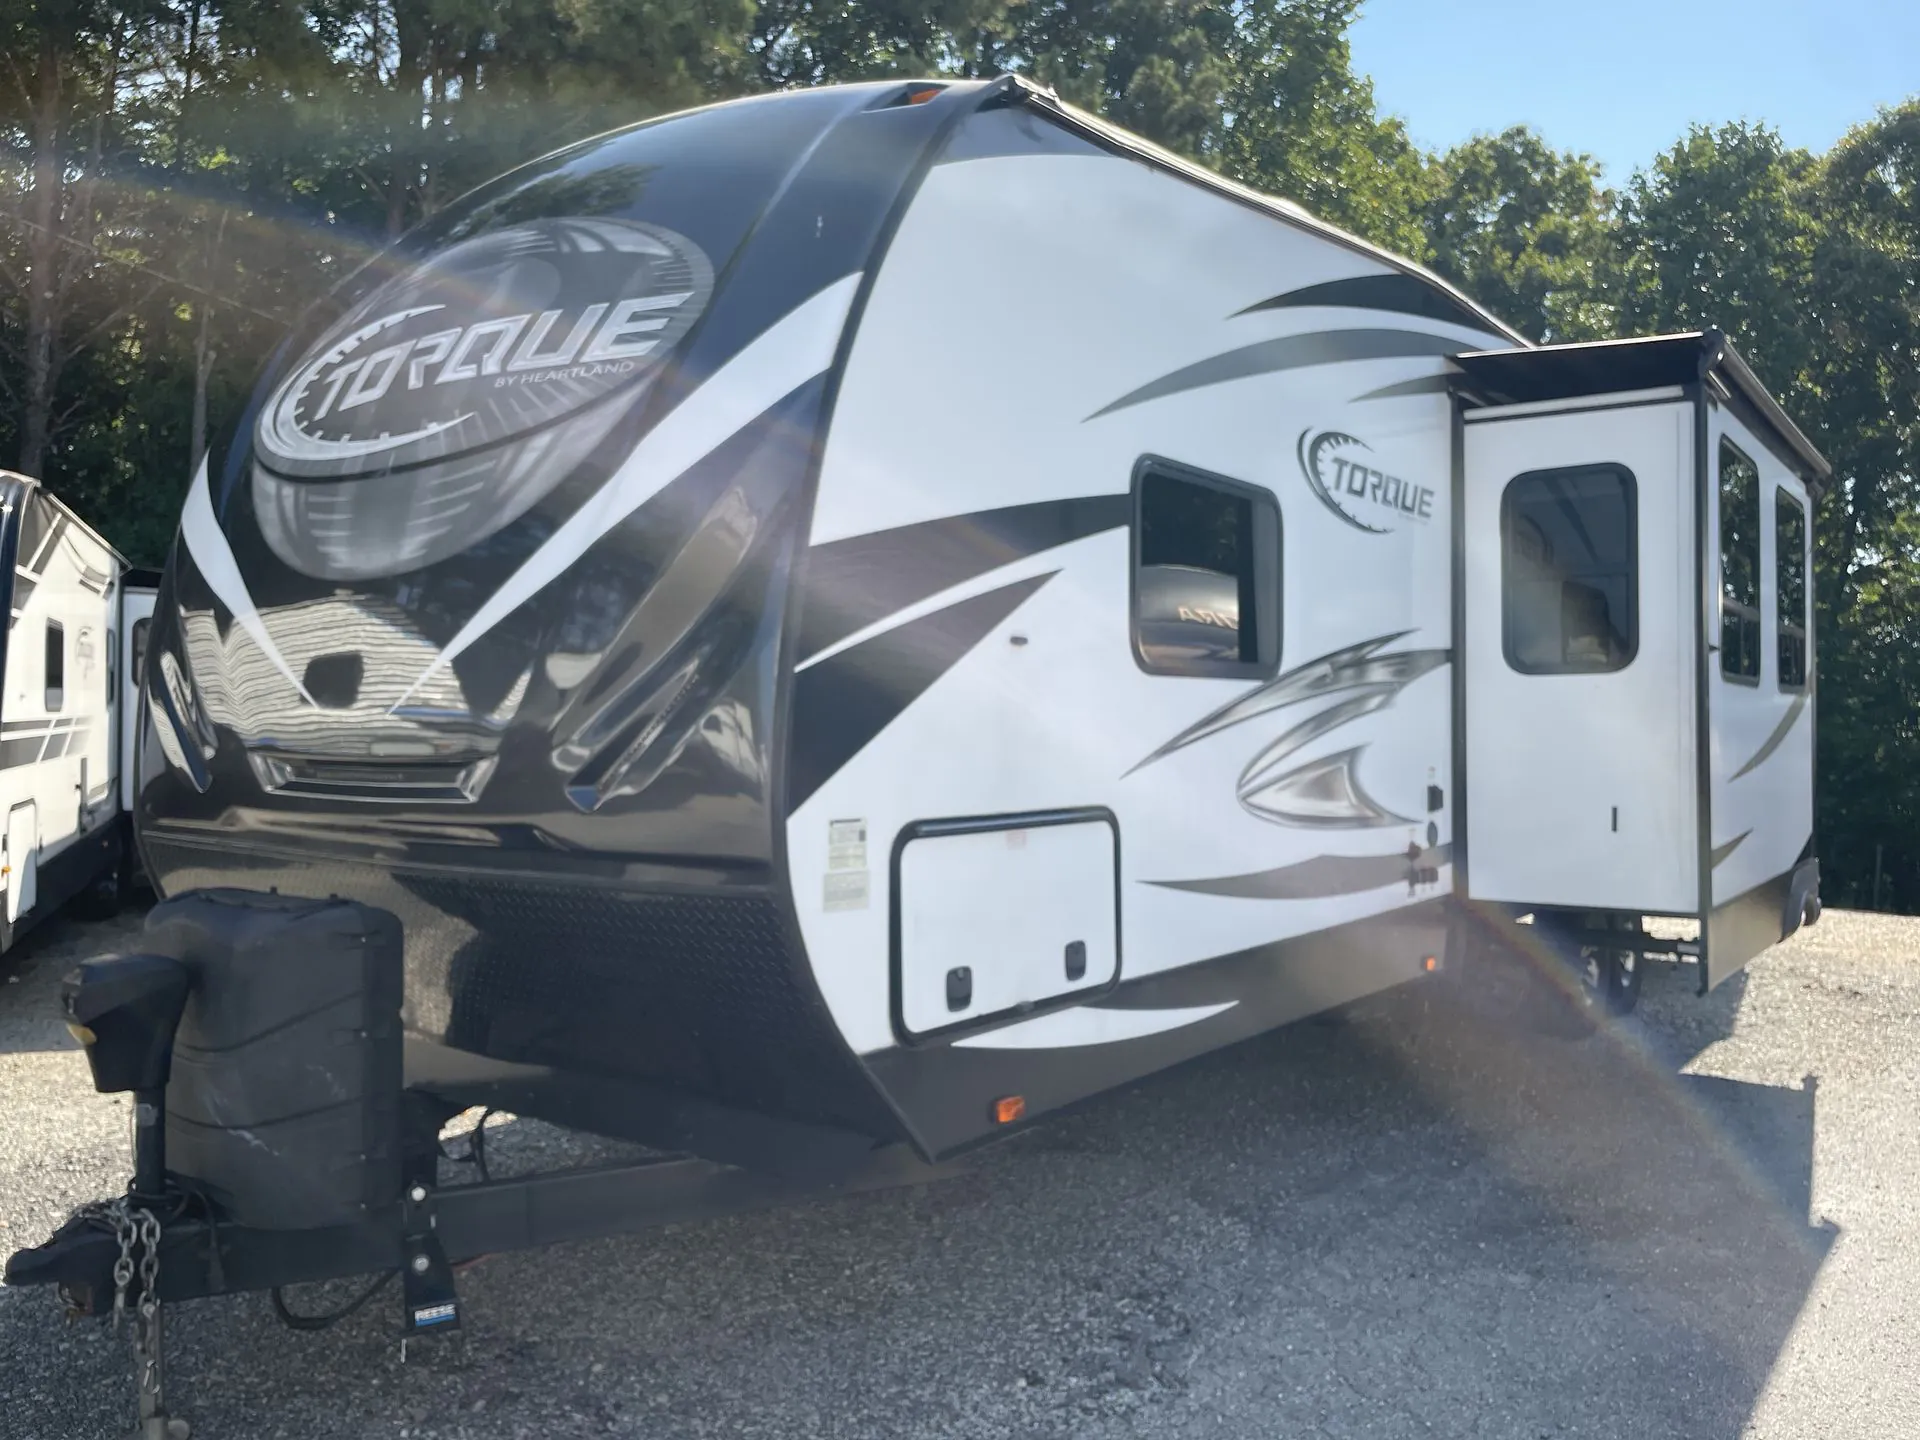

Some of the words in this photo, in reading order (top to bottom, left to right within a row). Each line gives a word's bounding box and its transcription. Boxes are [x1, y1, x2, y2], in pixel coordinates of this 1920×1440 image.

[313, 291, 695, 421] TORQUE
[493, 375, 518, 388] BY
[520, 359, 635, 385] HEARTLAND
[1331, 457, 1435, 519] TORQUE
